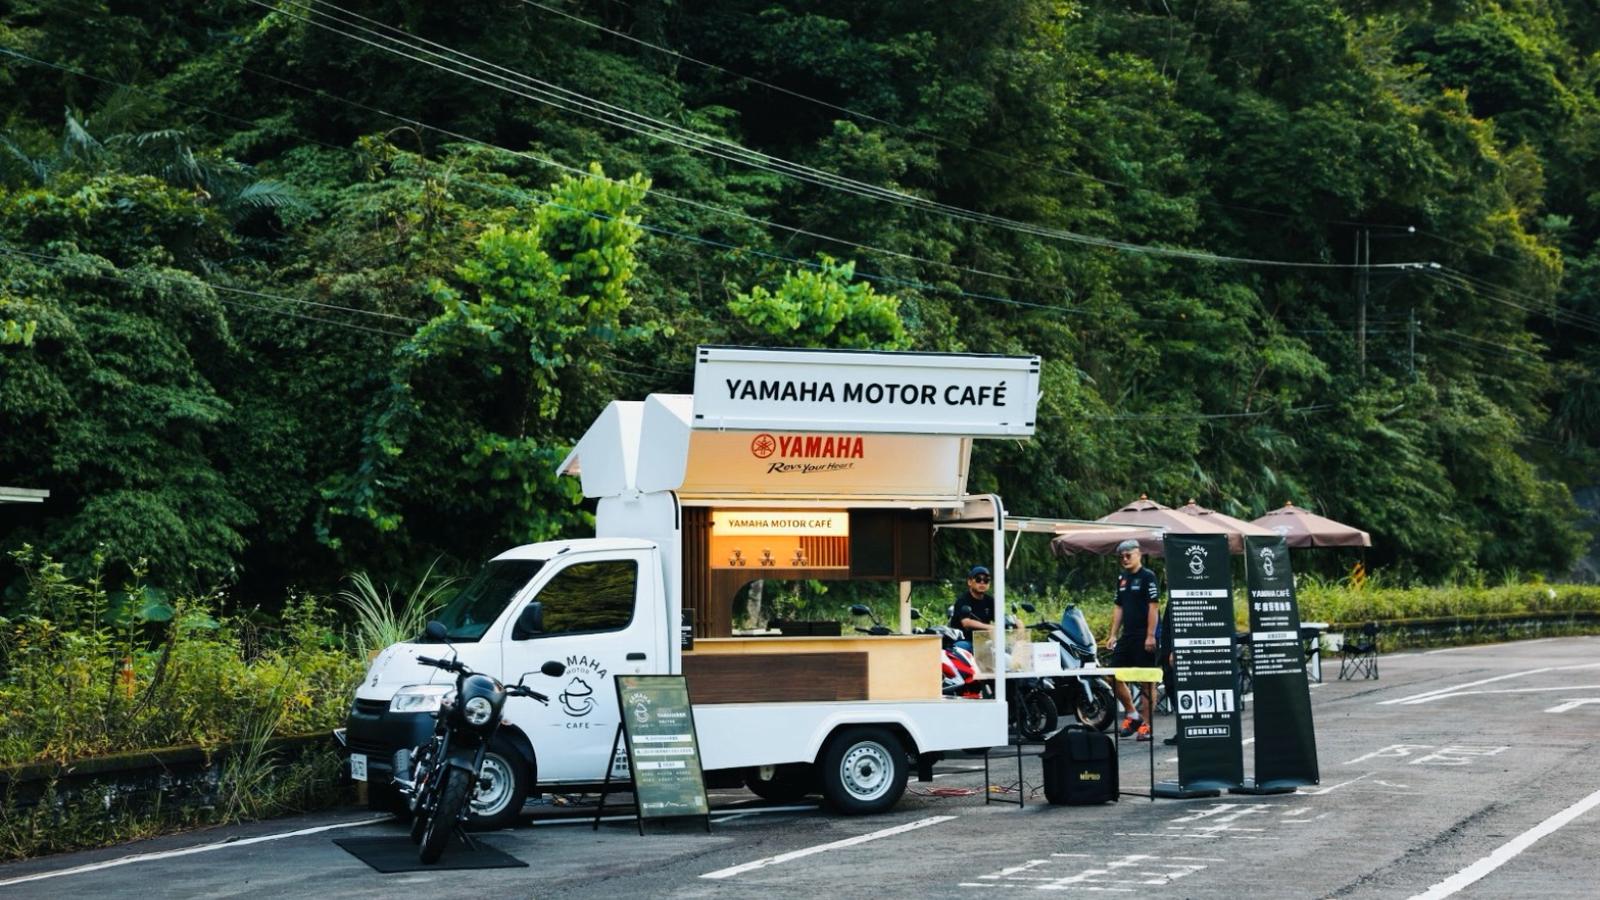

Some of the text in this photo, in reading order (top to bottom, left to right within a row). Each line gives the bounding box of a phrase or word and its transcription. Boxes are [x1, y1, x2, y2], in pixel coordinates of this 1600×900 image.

[726, 379, 1007, 407] YAMAHA MOTOR CAFÉ
[779, 436, 864, 459] YAMAHA
[767, 461, 802, 474] Revs
[826, 461, 855, 471] Heart
[728, 517, 832, 529] YAMAHA MOTOR CAFÉ
[566, 654, 608, 680] MAHA
[566, 667, 590, 675] MOTOR
[566, 722, 590, 730] CAFE
